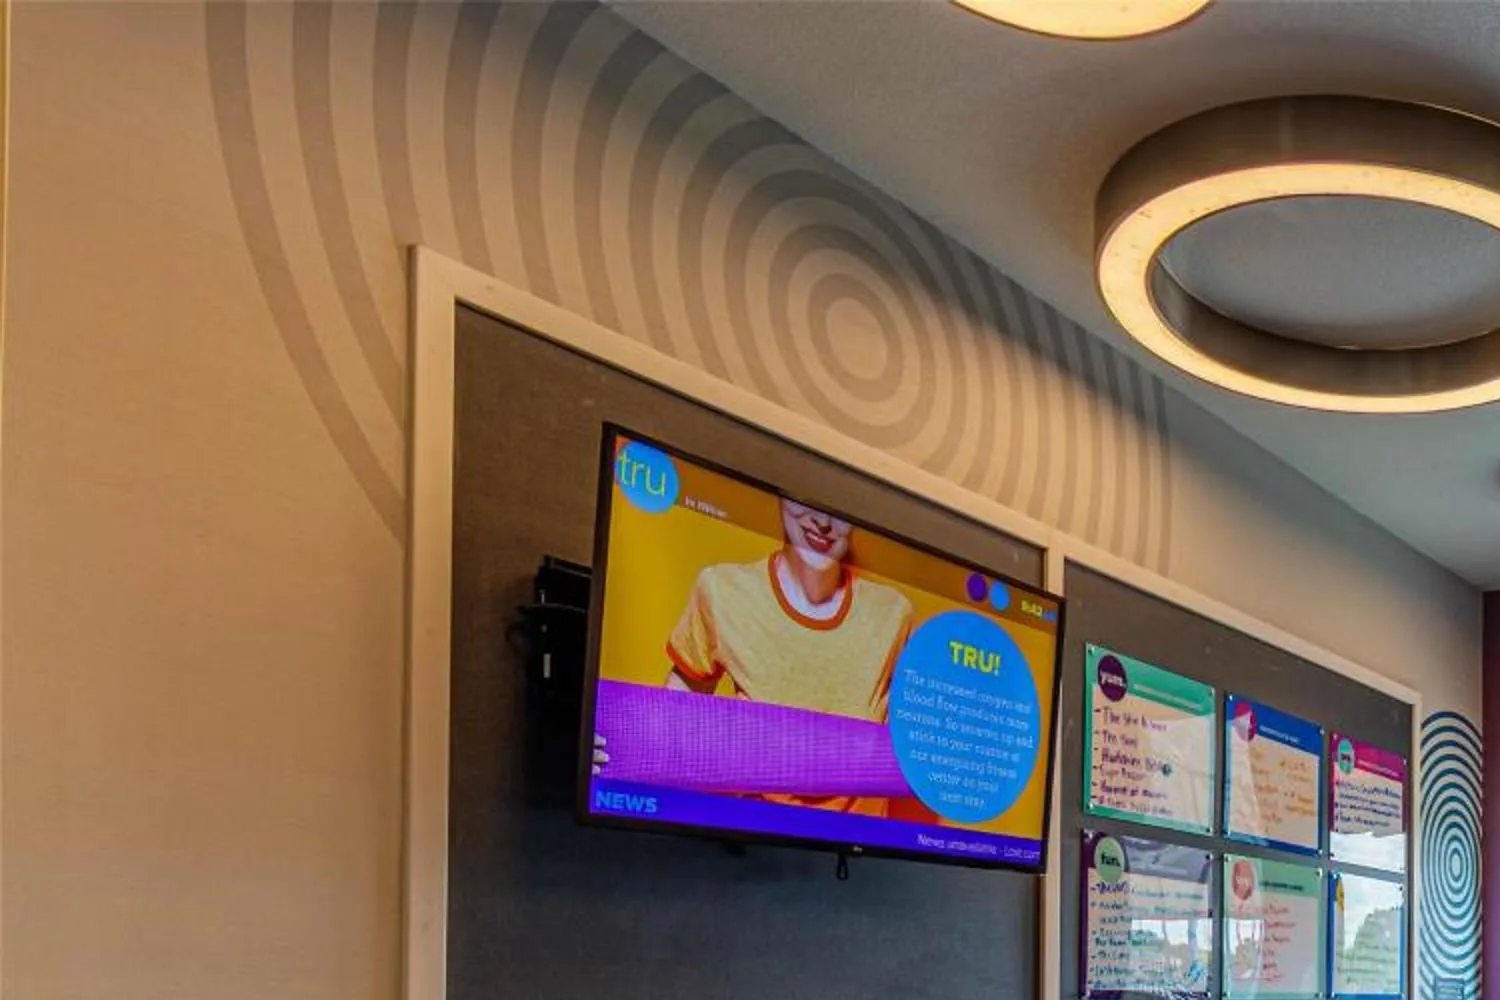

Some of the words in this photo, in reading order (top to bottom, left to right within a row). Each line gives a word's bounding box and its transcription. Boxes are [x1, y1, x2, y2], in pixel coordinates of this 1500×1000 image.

[618, 450, 666, 496] tru
[949, 640, 1001, 677] TRU!
[595, 789, 658, 813] NEWS
[917, 833, 945, 849] News
